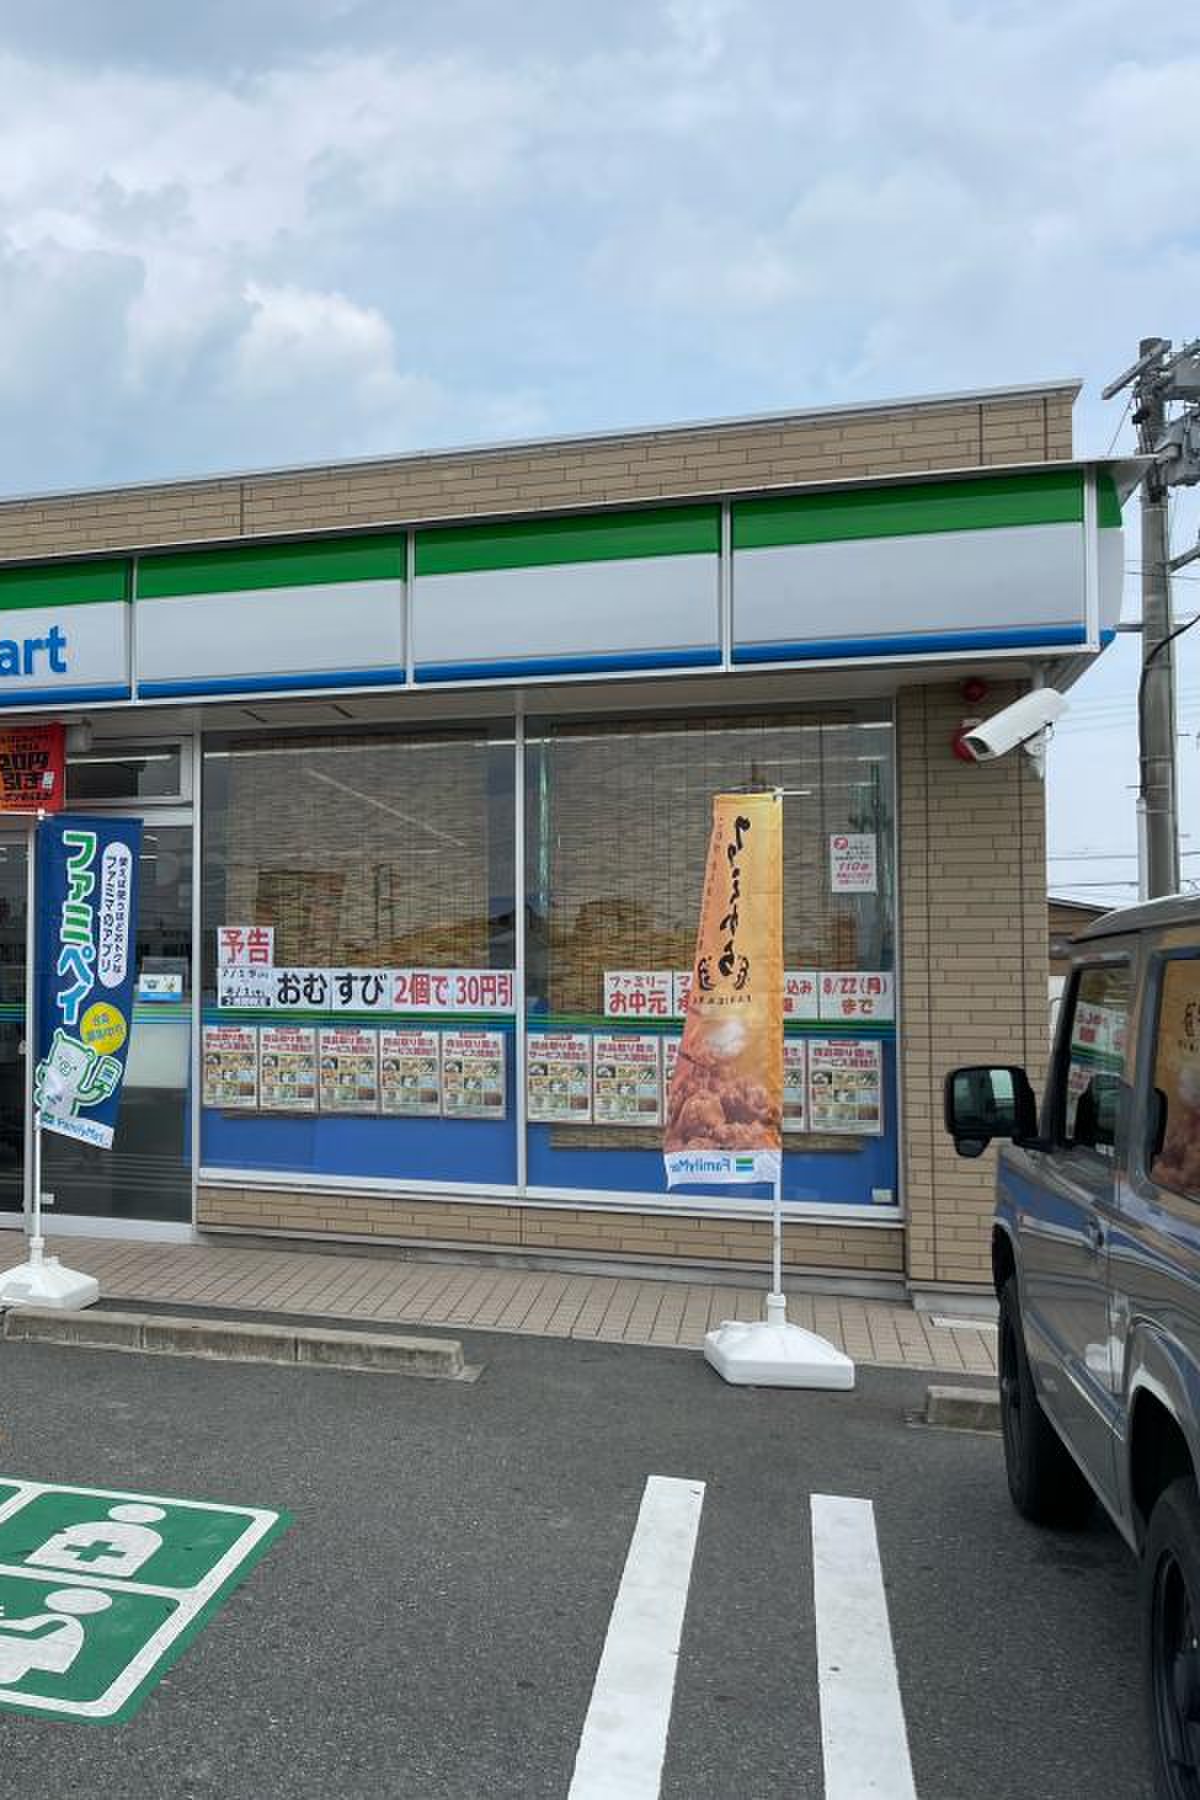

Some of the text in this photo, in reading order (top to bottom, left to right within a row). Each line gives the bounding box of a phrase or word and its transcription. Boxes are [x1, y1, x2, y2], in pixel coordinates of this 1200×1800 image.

[99, 856, 116, 972] ファミマのアプリ
[57, 829, 97, 1024] ファミペイ
[221, 928, 270, 963] 予告
[784, 979, 812, 995] 込み
[823, 977, 887, 995] 8/22(月)
[609, 990, 668, 1014] お中元
[842, 998, 873, 1014] まで
